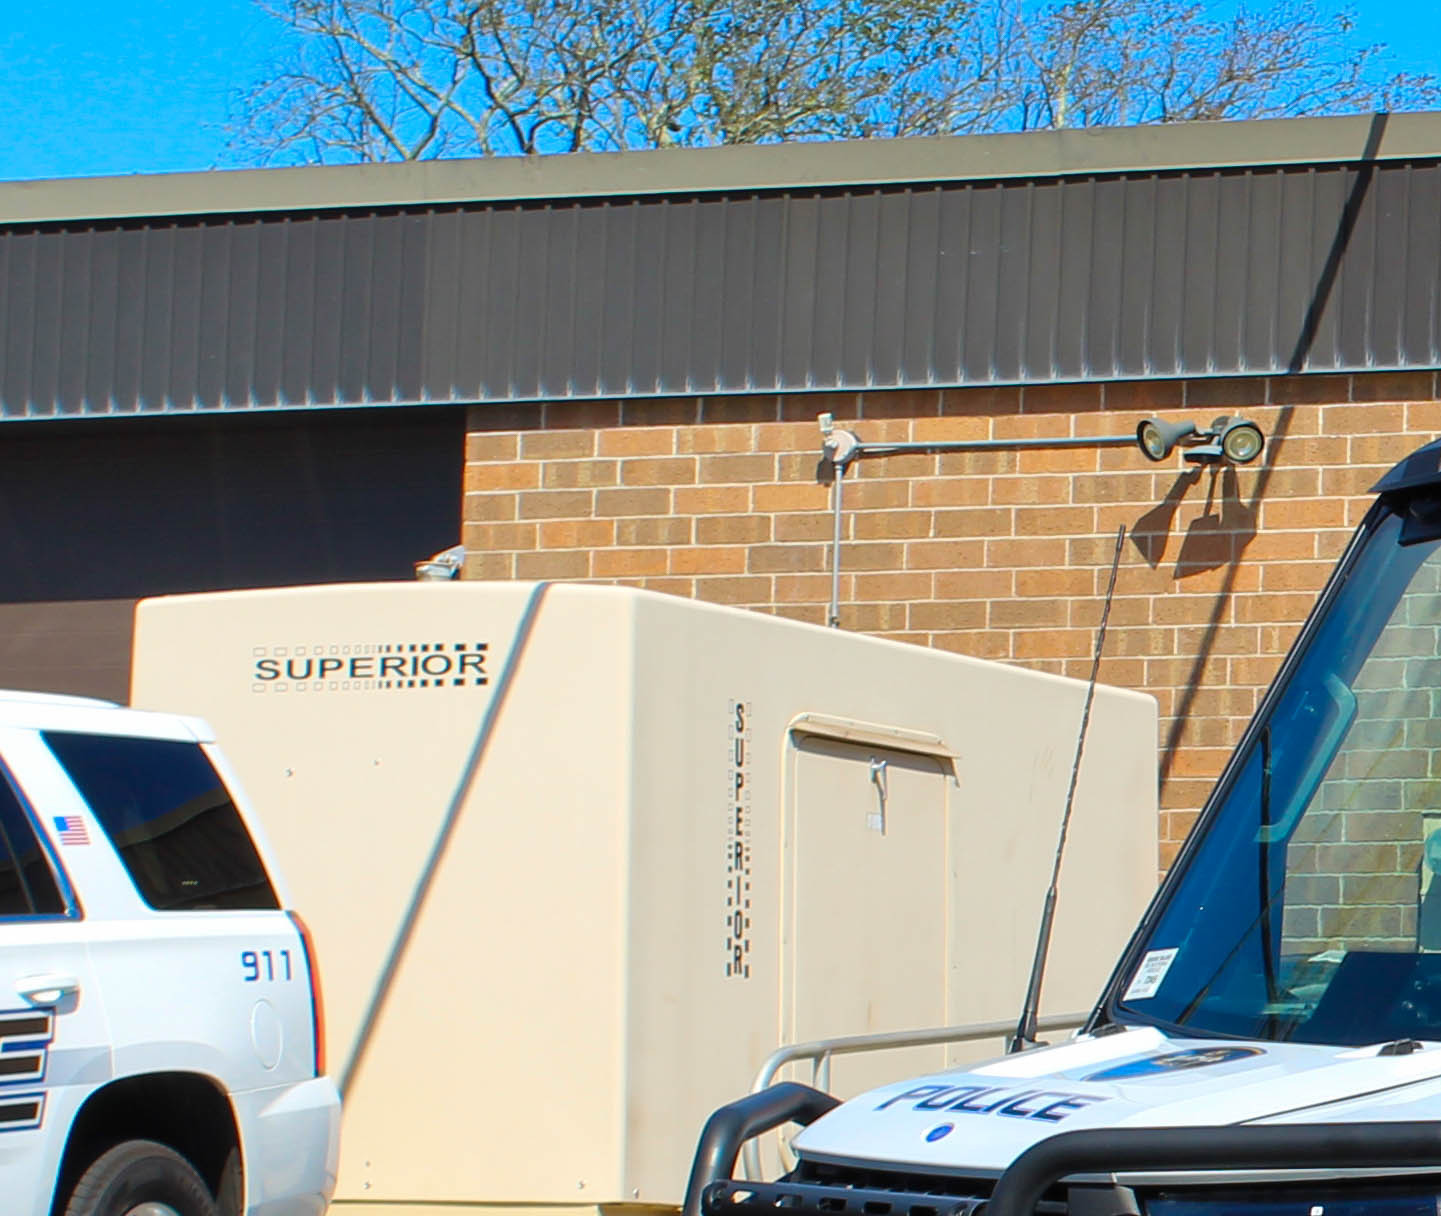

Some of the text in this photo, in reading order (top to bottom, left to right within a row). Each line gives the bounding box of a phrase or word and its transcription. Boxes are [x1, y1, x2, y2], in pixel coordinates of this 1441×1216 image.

[253, 653, 487, 681] SUPERIOR
[732, 702, 746, 975] SUPERIOR
[241, 950, 292, 982] 911
[872, 1084, 1115, 1124] POLICE
